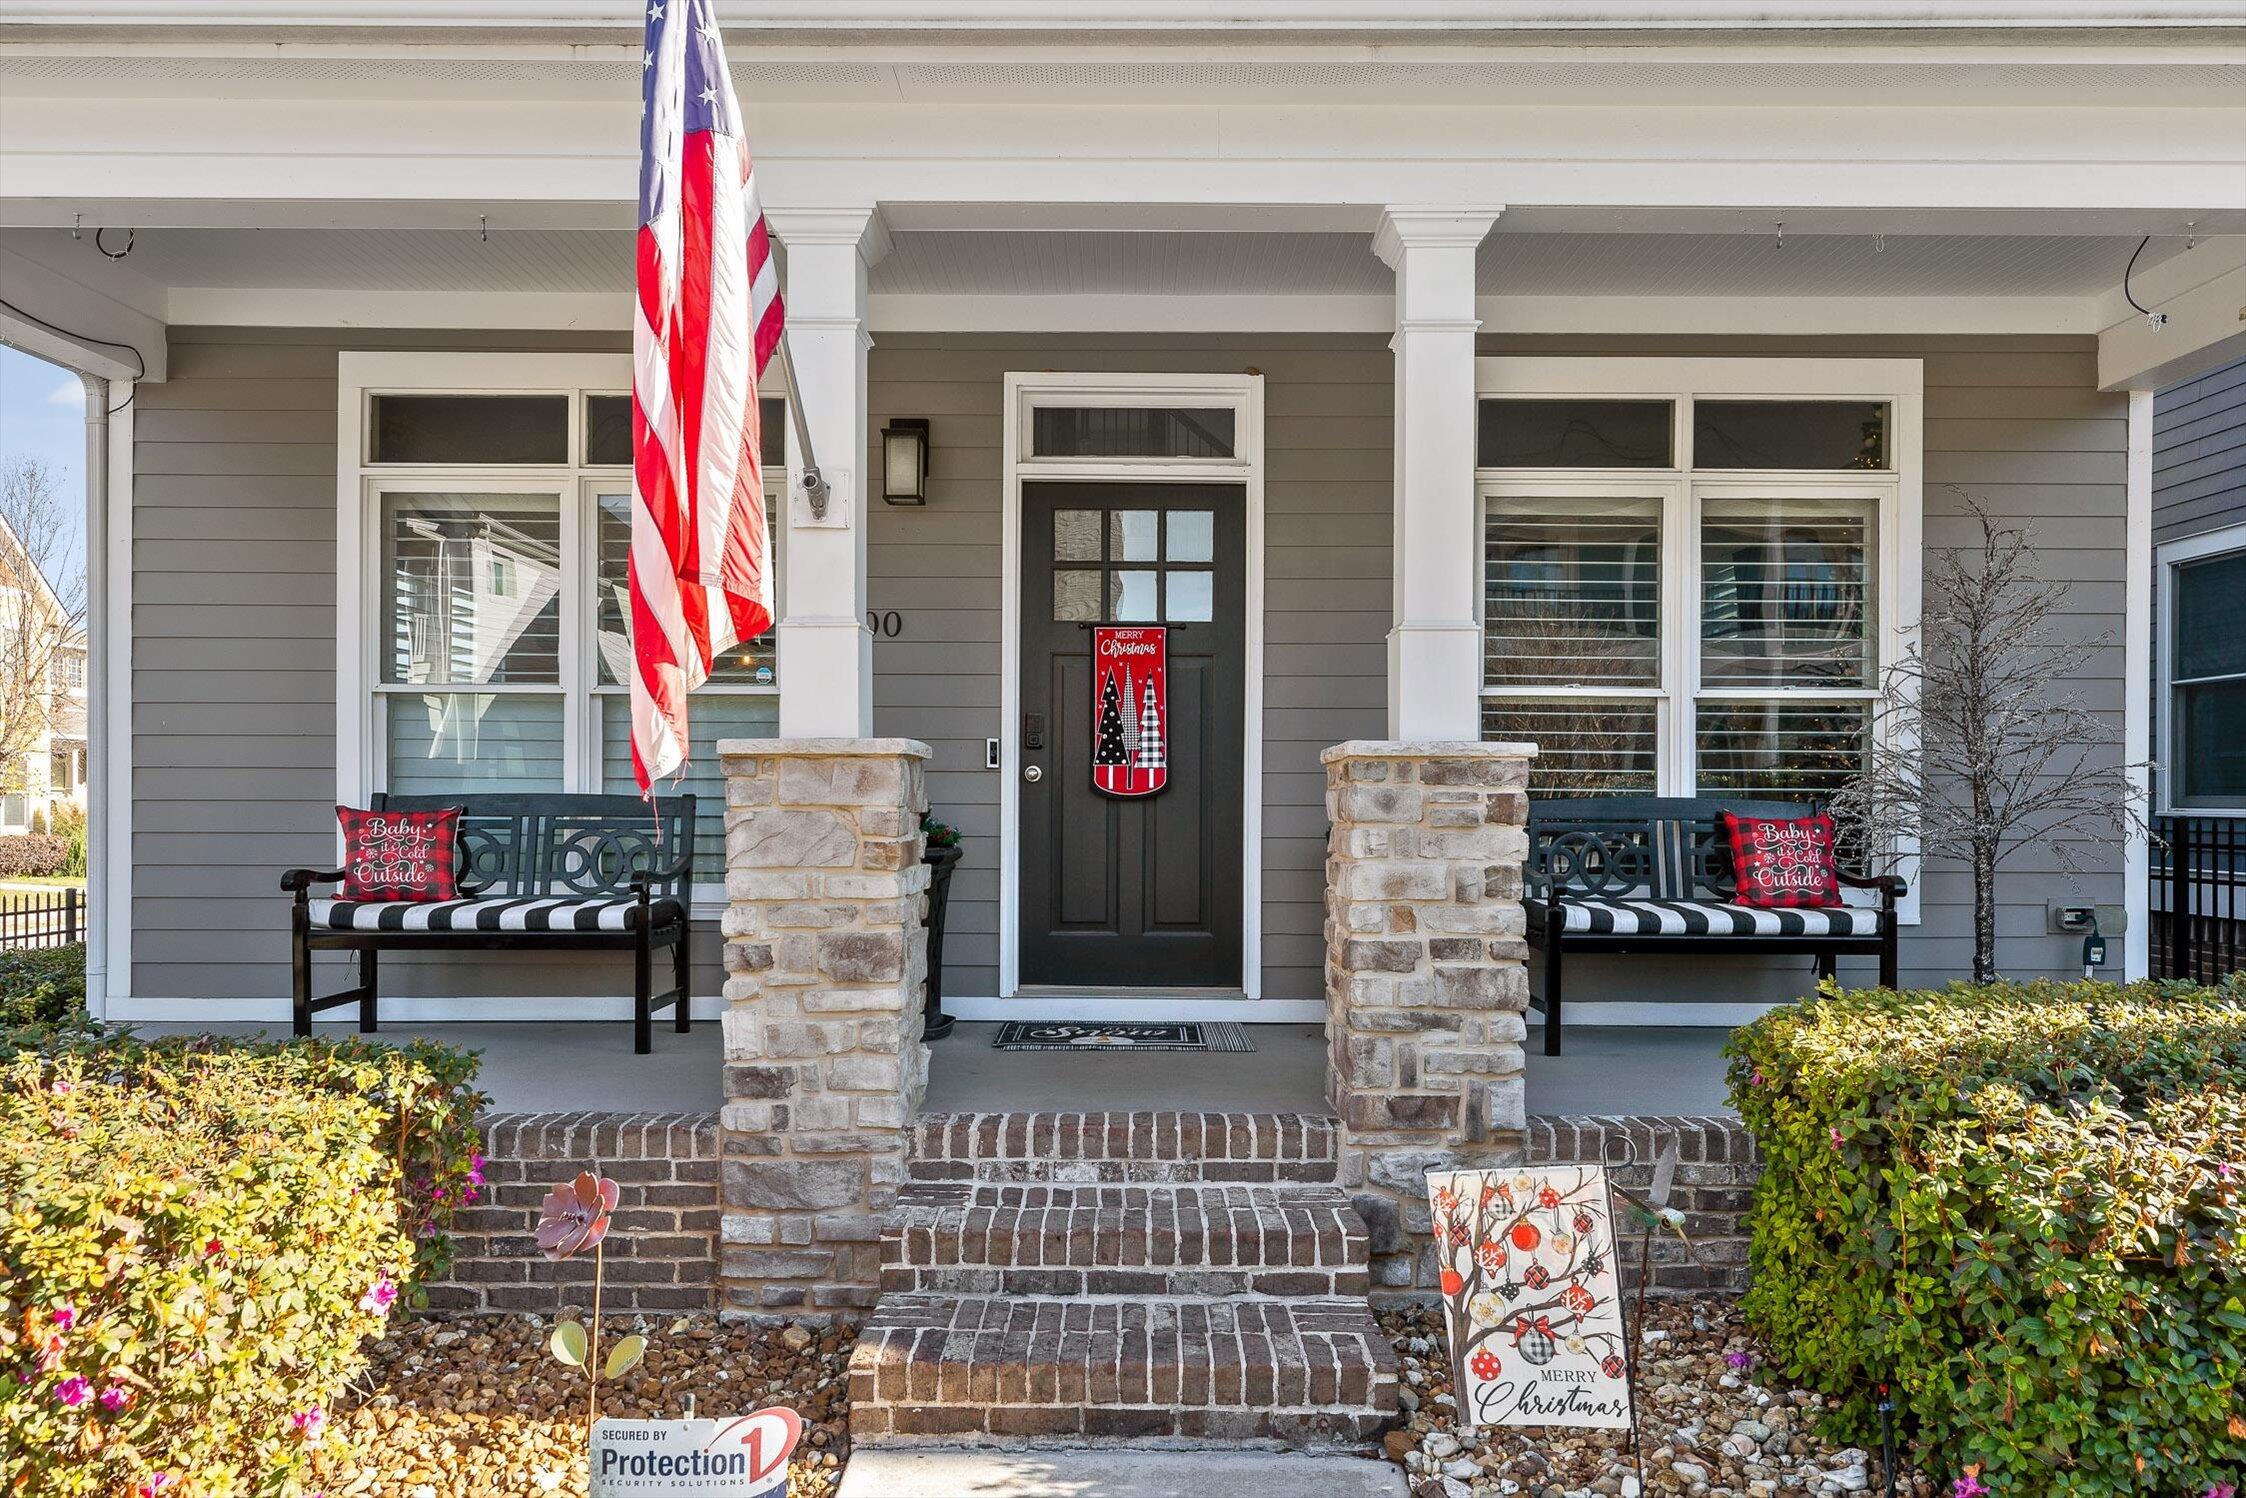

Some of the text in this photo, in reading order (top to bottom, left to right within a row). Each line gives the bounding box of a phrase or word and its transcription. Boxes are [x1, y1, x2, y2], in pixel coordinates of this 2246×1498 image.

[1115, 630, 1144, 639] MERRY
[1100, 639, 1157, 658] Christmas
[360, 817, 436, 846] Baby
[1754, 822, 1825, 850] Baby
[399, 843, 431, 859] Cold
[1794, 848, 1821, 863] Cold
[353, 857, 428, 883] Outside
[1752, 861, 1823, 887] Outside
[1540, 1369, 1598, 1383] MERRY
[1474, 1380, 1628, 1424] Christmas
[602, 1429, 667, 1441] SECURED BY
[601, 1448, 745, 1477] Protection
[602, 1478, 745, 1488] SECURITY SOLUTIONS
